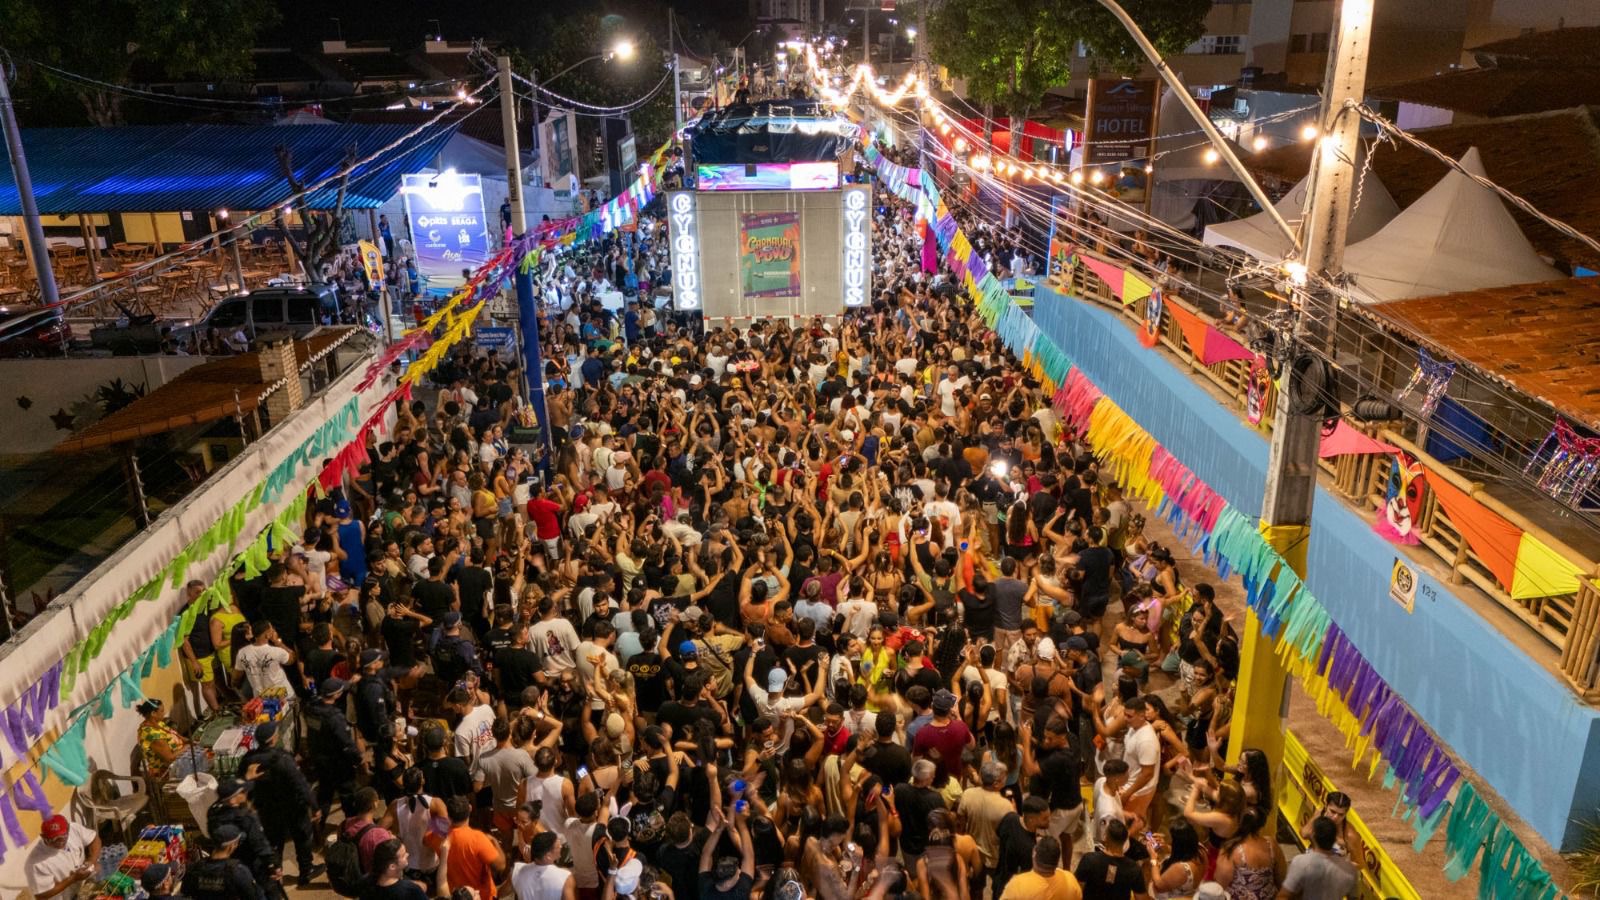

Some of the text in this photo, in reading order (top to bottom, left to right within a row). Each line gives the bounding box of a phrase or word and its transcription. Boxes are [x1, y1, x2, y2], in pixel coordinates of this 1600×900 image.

[1096, 119, 1145, 133] HOTEL
[673, 194, 698, 308] CYGNUS
[845, 190, 866, 306] CYGNUS
[1422, 584, 1437, 602] 123
